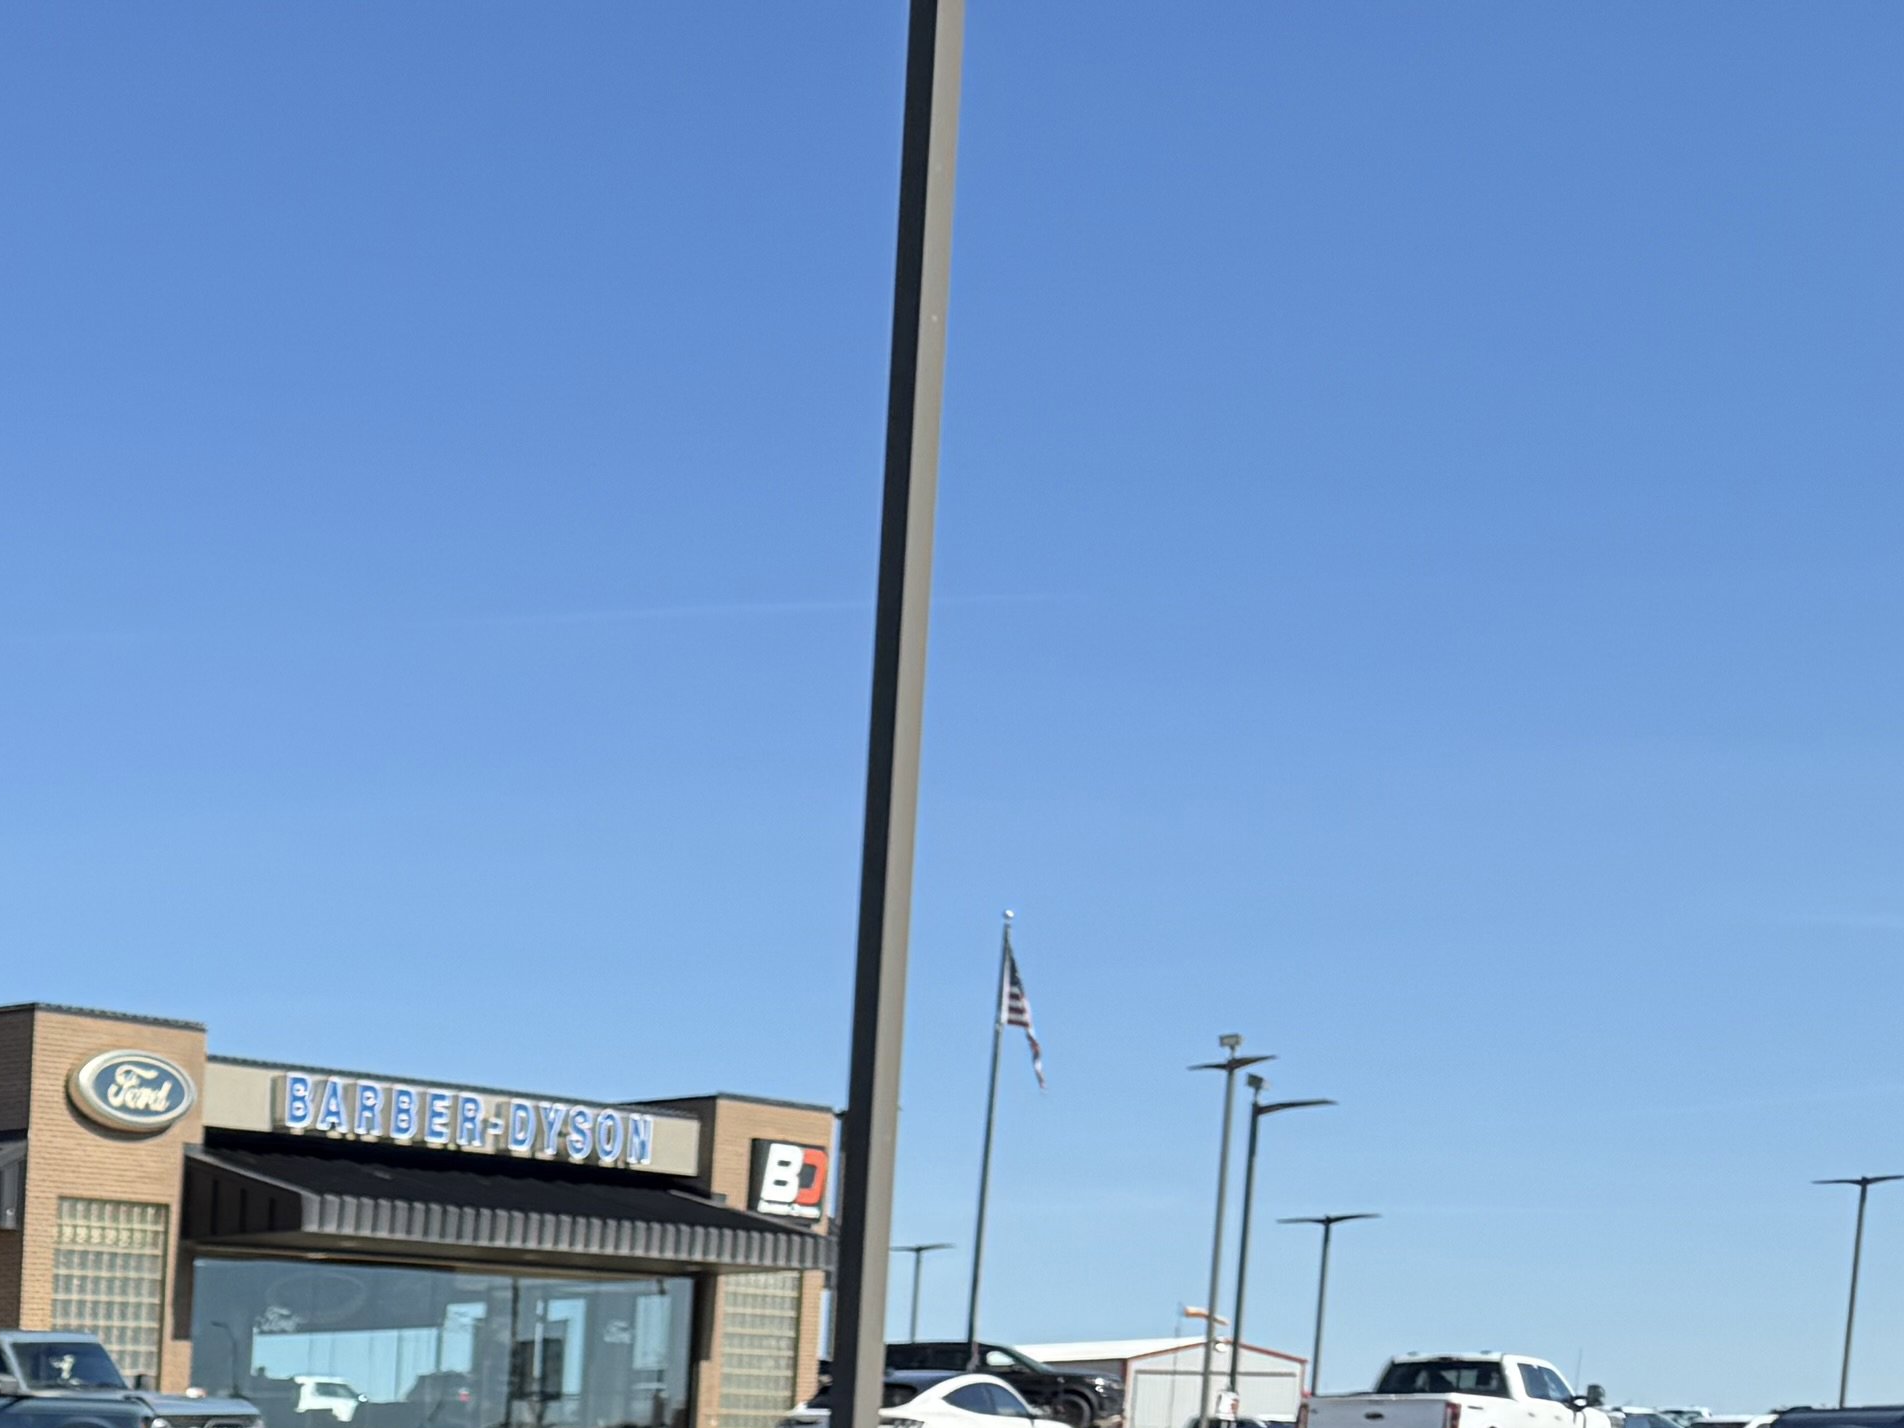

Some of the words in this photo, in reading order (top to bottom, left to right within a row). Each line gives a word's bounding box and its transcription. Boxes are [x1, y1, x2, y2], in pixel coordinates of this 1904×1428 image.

[107, 1064, 172, 1112] Ford
[286, 1071, 653, 1165] BARBER-DYSON
[760, 1143, 828, 1206] BD
